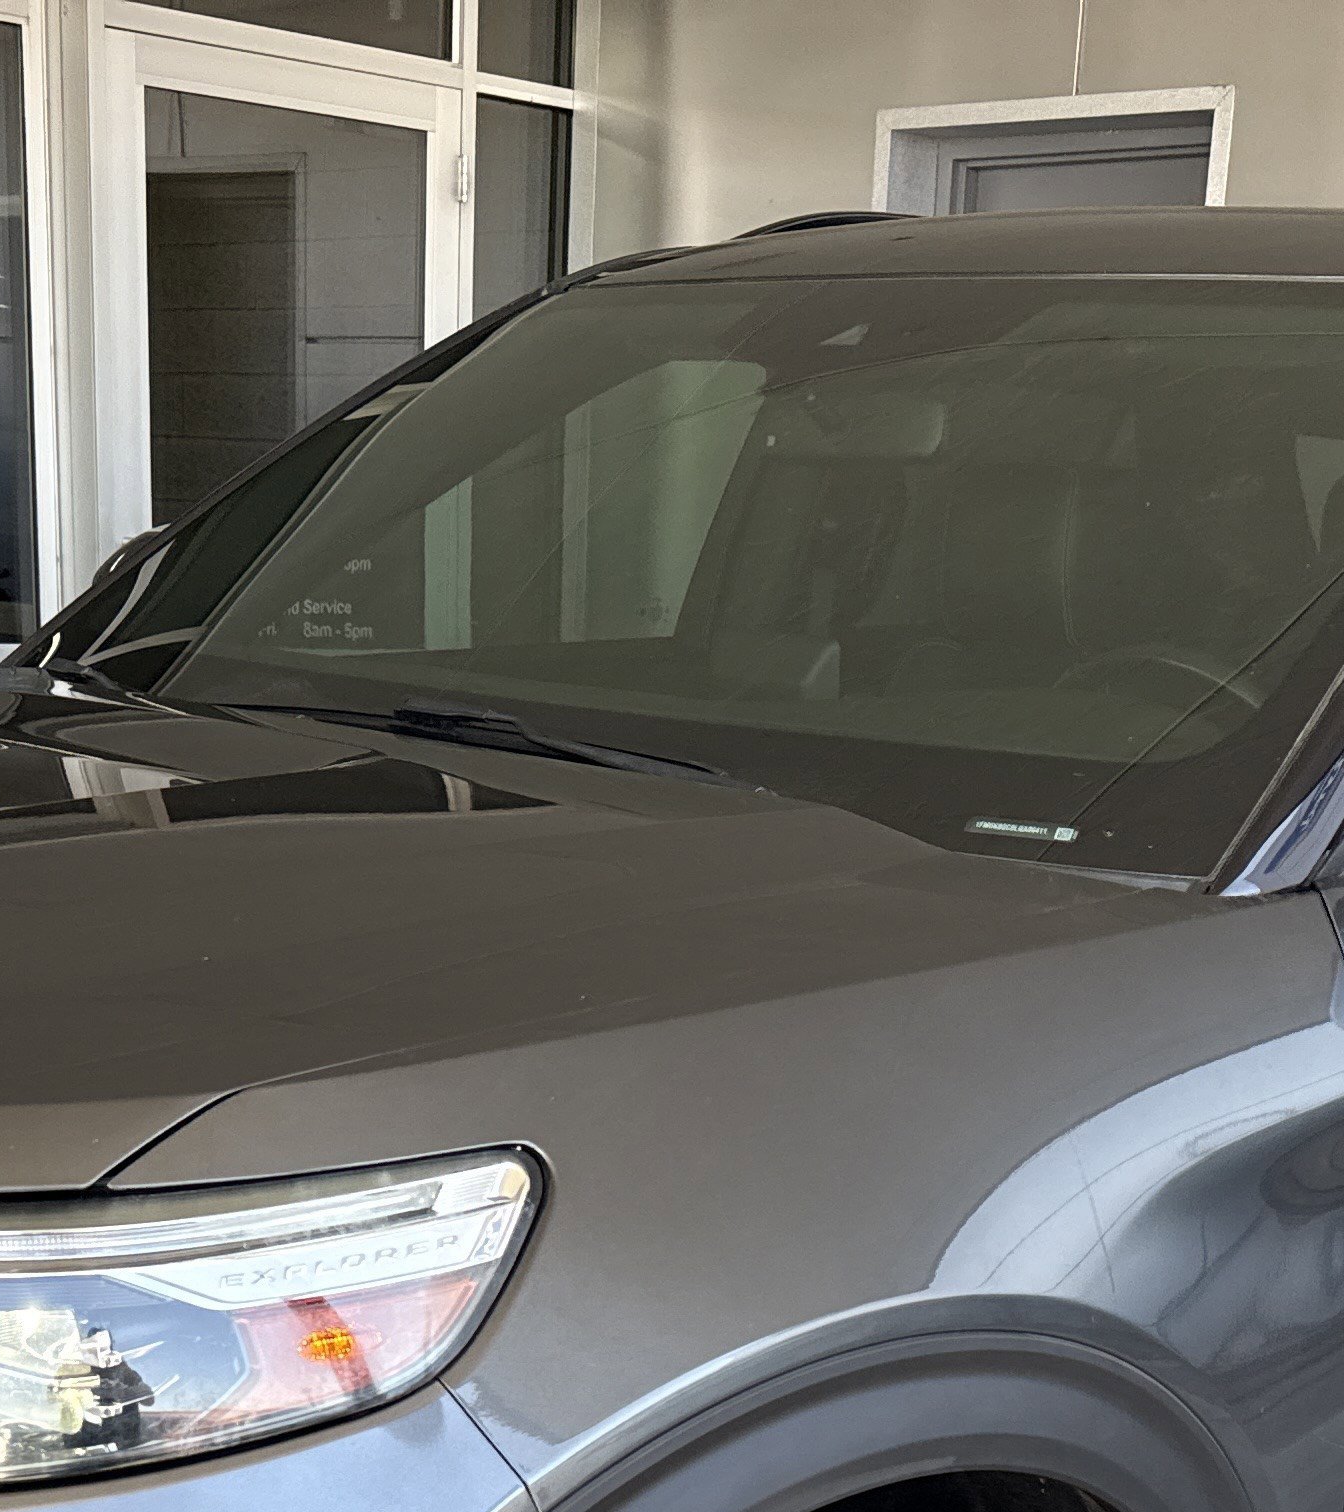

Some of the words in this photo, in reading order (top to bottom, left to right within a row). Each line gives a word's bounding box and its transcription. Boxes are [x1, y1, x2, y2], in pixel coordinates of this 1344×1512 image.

[303, 599, 352, 615] Service
[303, 621, 332, 638] 8am
[344, 622, 373, 640] 5pm
[218, 1233, 459, 1289] EXPLORER
